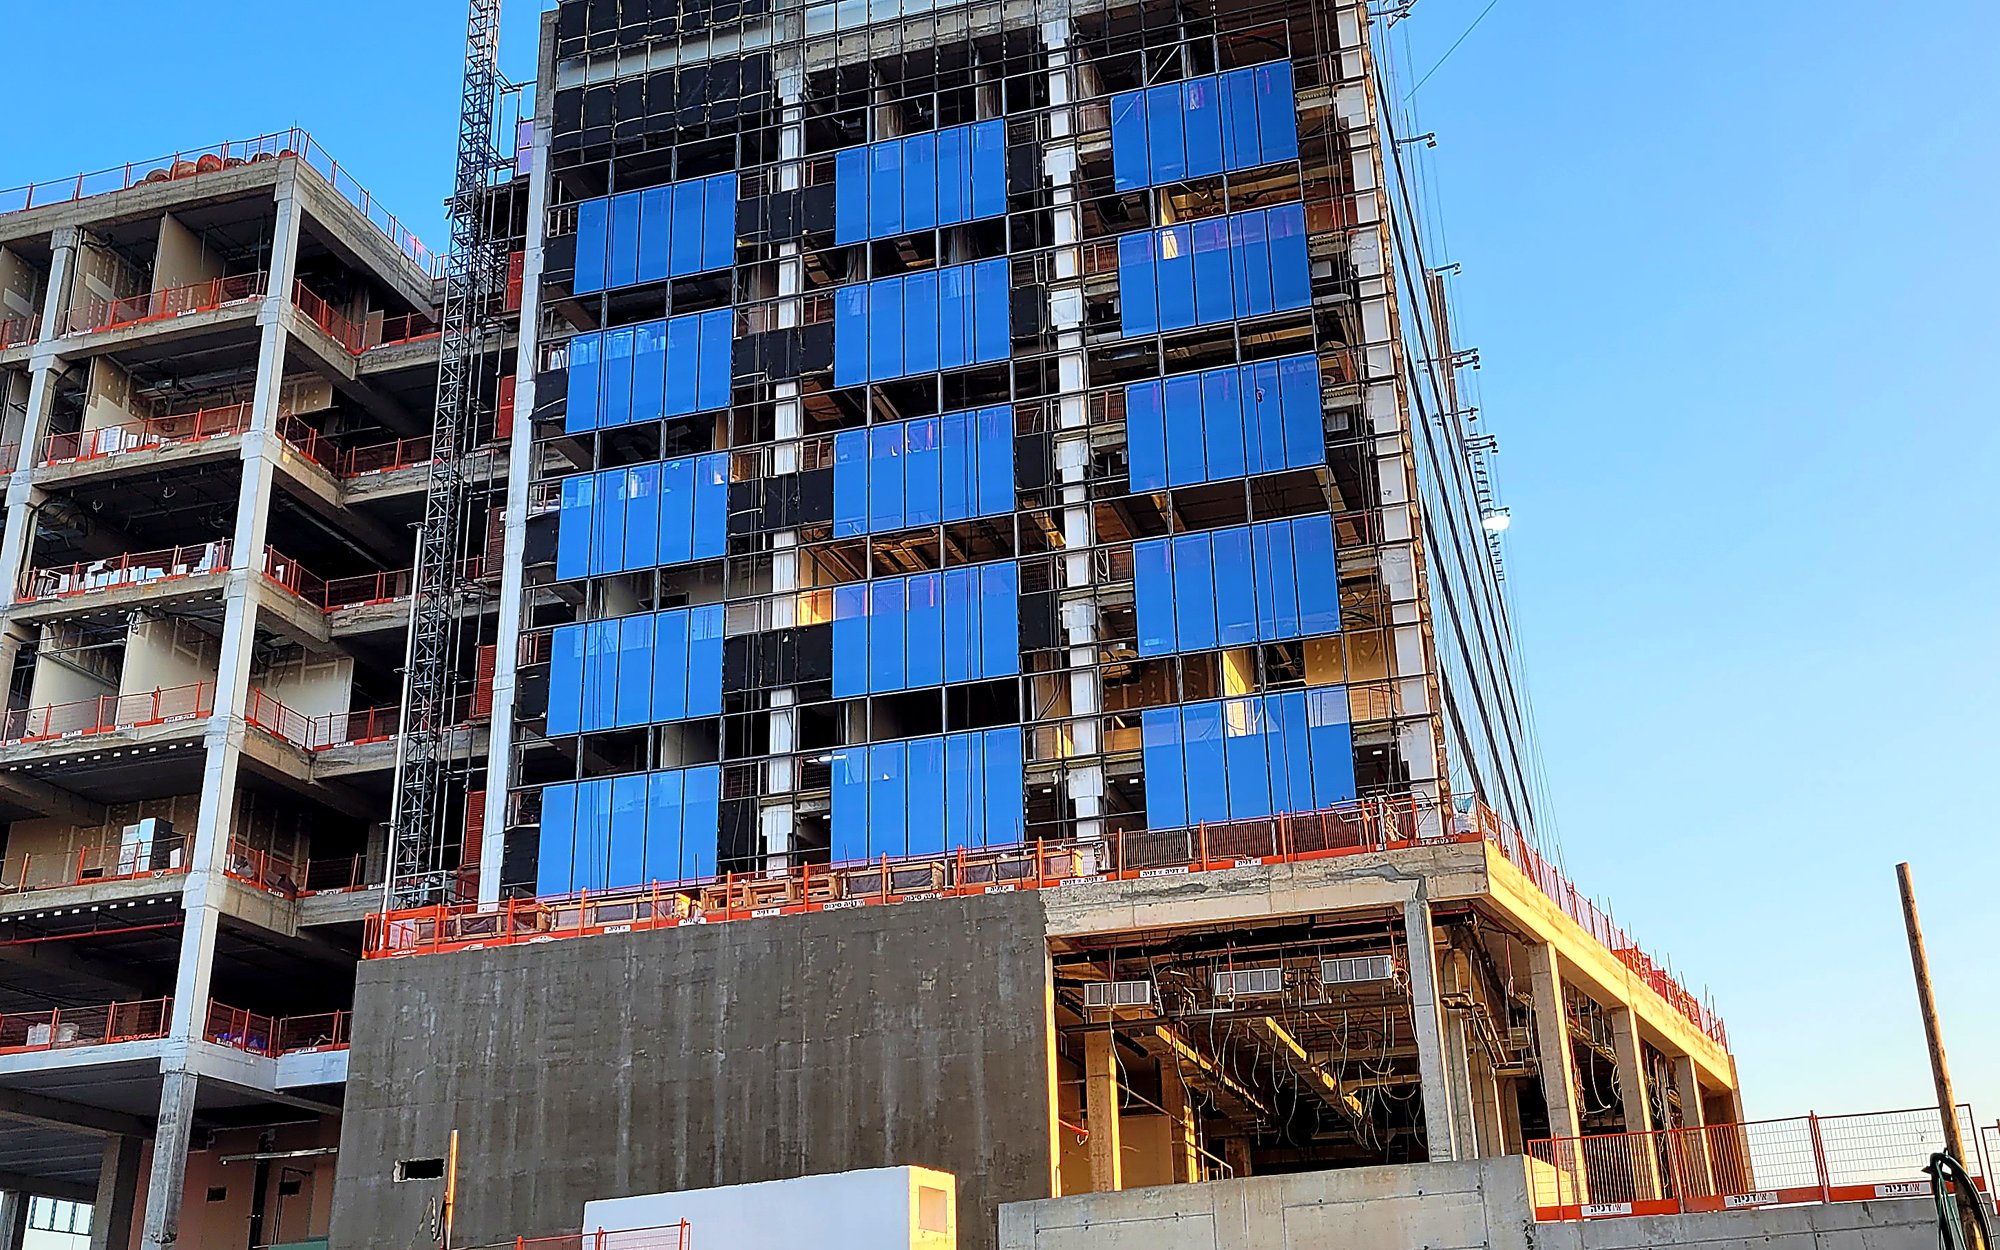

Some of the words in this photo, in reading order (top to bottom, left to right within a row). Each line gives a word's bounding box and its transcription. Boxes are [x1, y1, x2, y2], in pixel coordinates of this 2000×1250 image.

[1884, 1183, 1909, 1193] דניה
[1733, 1193, 1757, 1204] דניה
[1590, 1204, 1612, 1213] דניה
